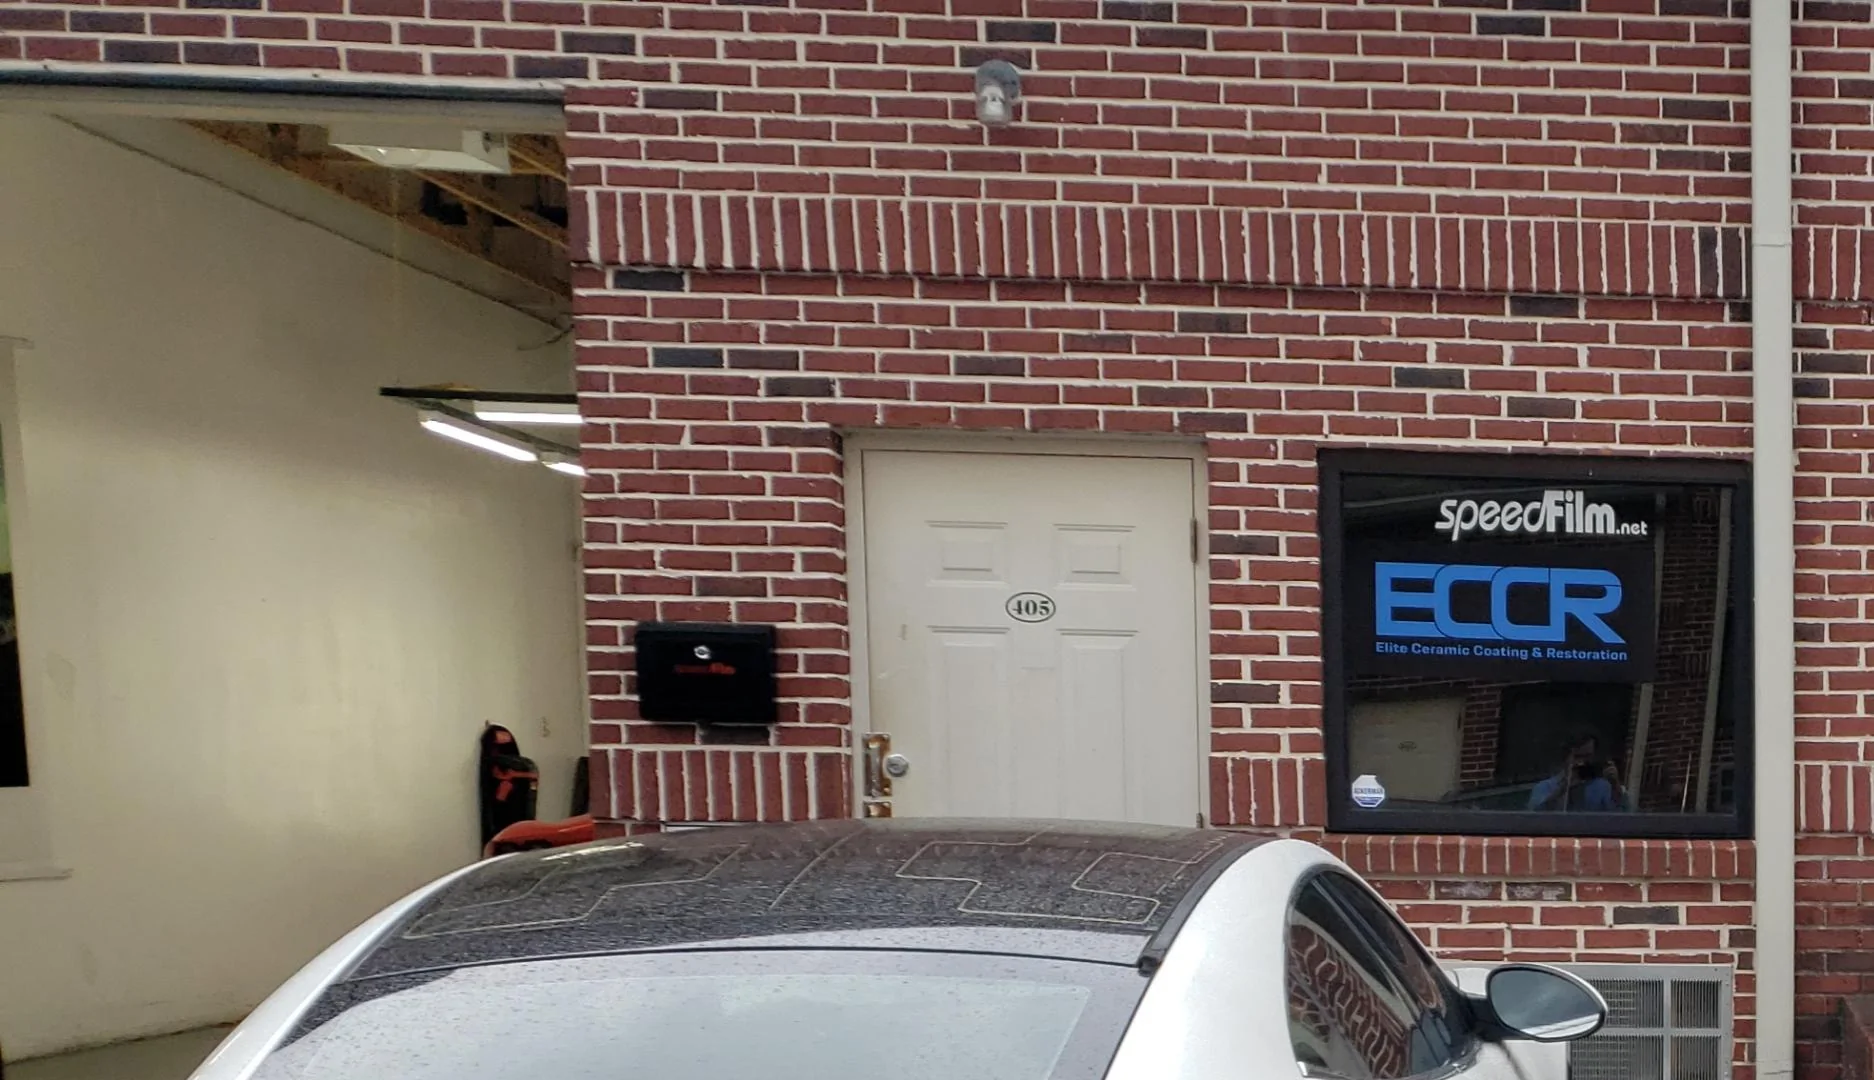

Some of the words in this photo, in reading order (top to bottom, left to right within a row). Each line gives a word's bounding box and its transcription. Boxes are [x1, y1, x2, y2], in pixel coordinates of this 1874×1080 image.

[1012, 599, 1050, 615] 405
[1375, 561, 1626, 643] ECCR
[1375, 642, 1408, 653] Elite
[1411, 643, 1470, 656] Ceramic
[1473, 644, 1528, 660] Coating
[1532, 647, 1542, 658] &
[1546, 648, 1627, 660] Restoration
